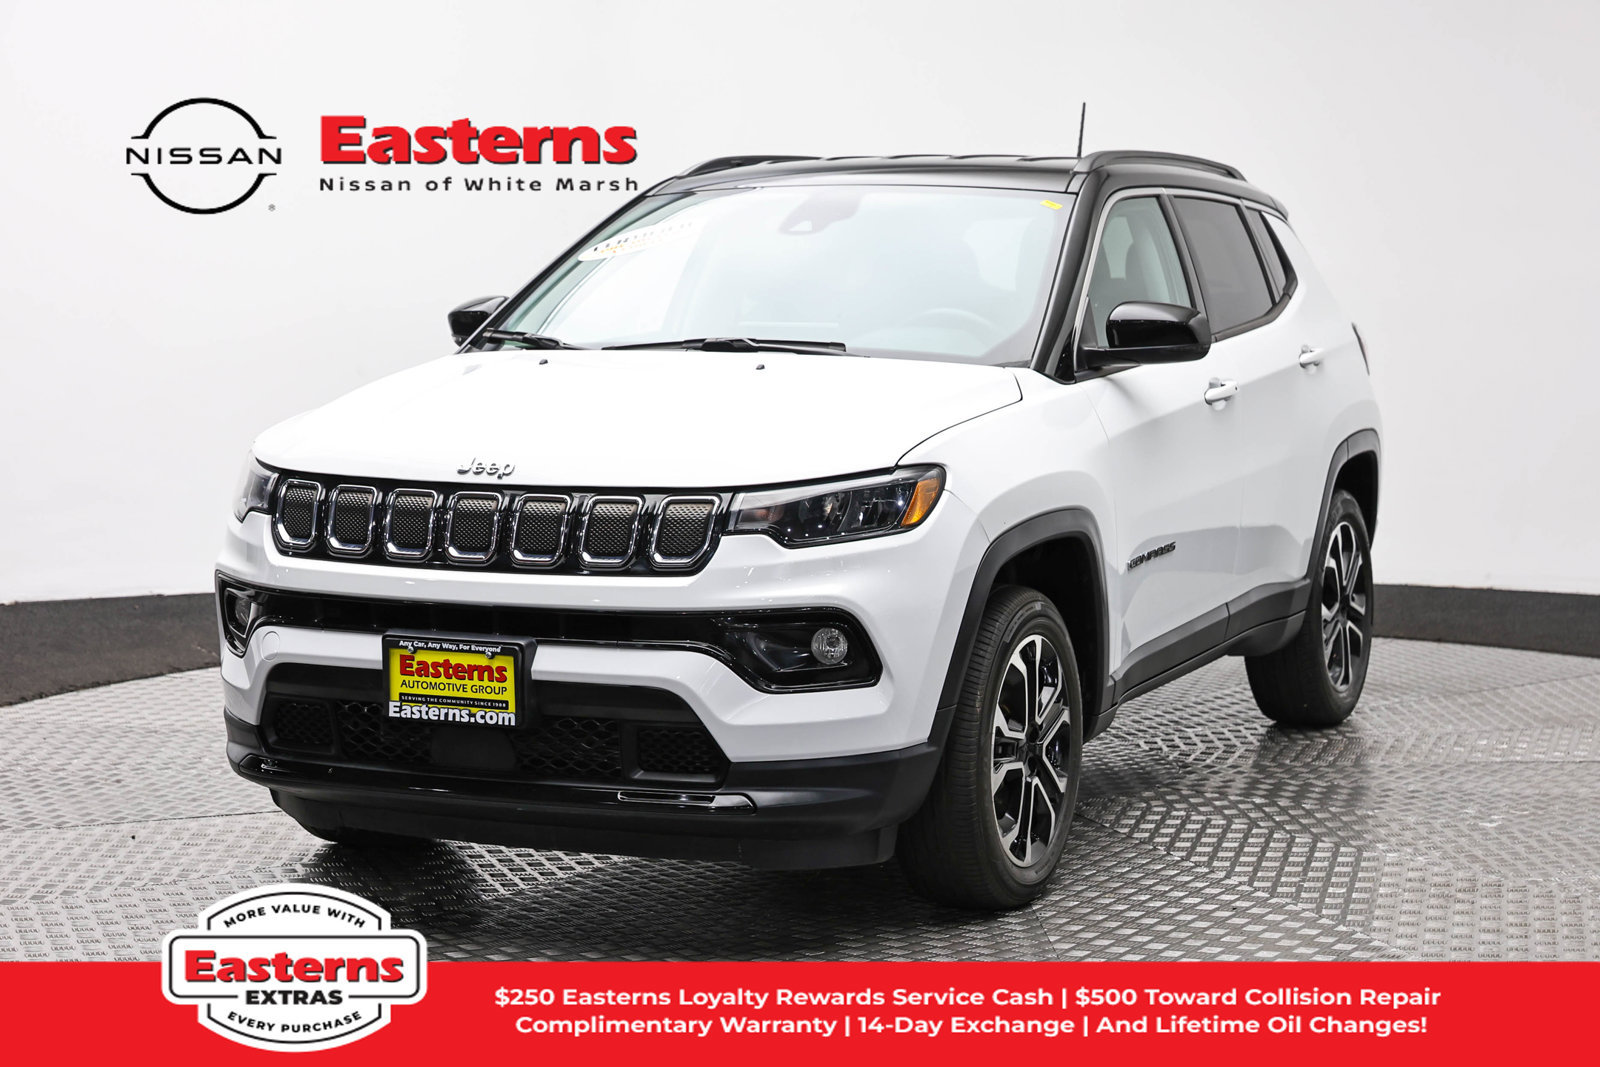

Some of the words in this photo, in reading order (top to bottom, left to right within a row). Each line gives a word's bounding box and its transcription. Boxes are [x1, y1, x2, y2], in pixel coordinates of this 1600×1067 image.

[456, 457, 515, 480] Jeep
[399, 640, 413, 648] Any
[413, 641, 427, 649] Car,
[427, 642, 441, 650] Any
[441, 642, 459, 651] Way,
[459, 643, 471, 651] For
[399, 654, 508, 683] Easterns
[400, 679, 468, 693] AUTOMOTIVE
[471, 684, 508, 695] GROUP
[388, 701, 516, 726] Easterns.com
